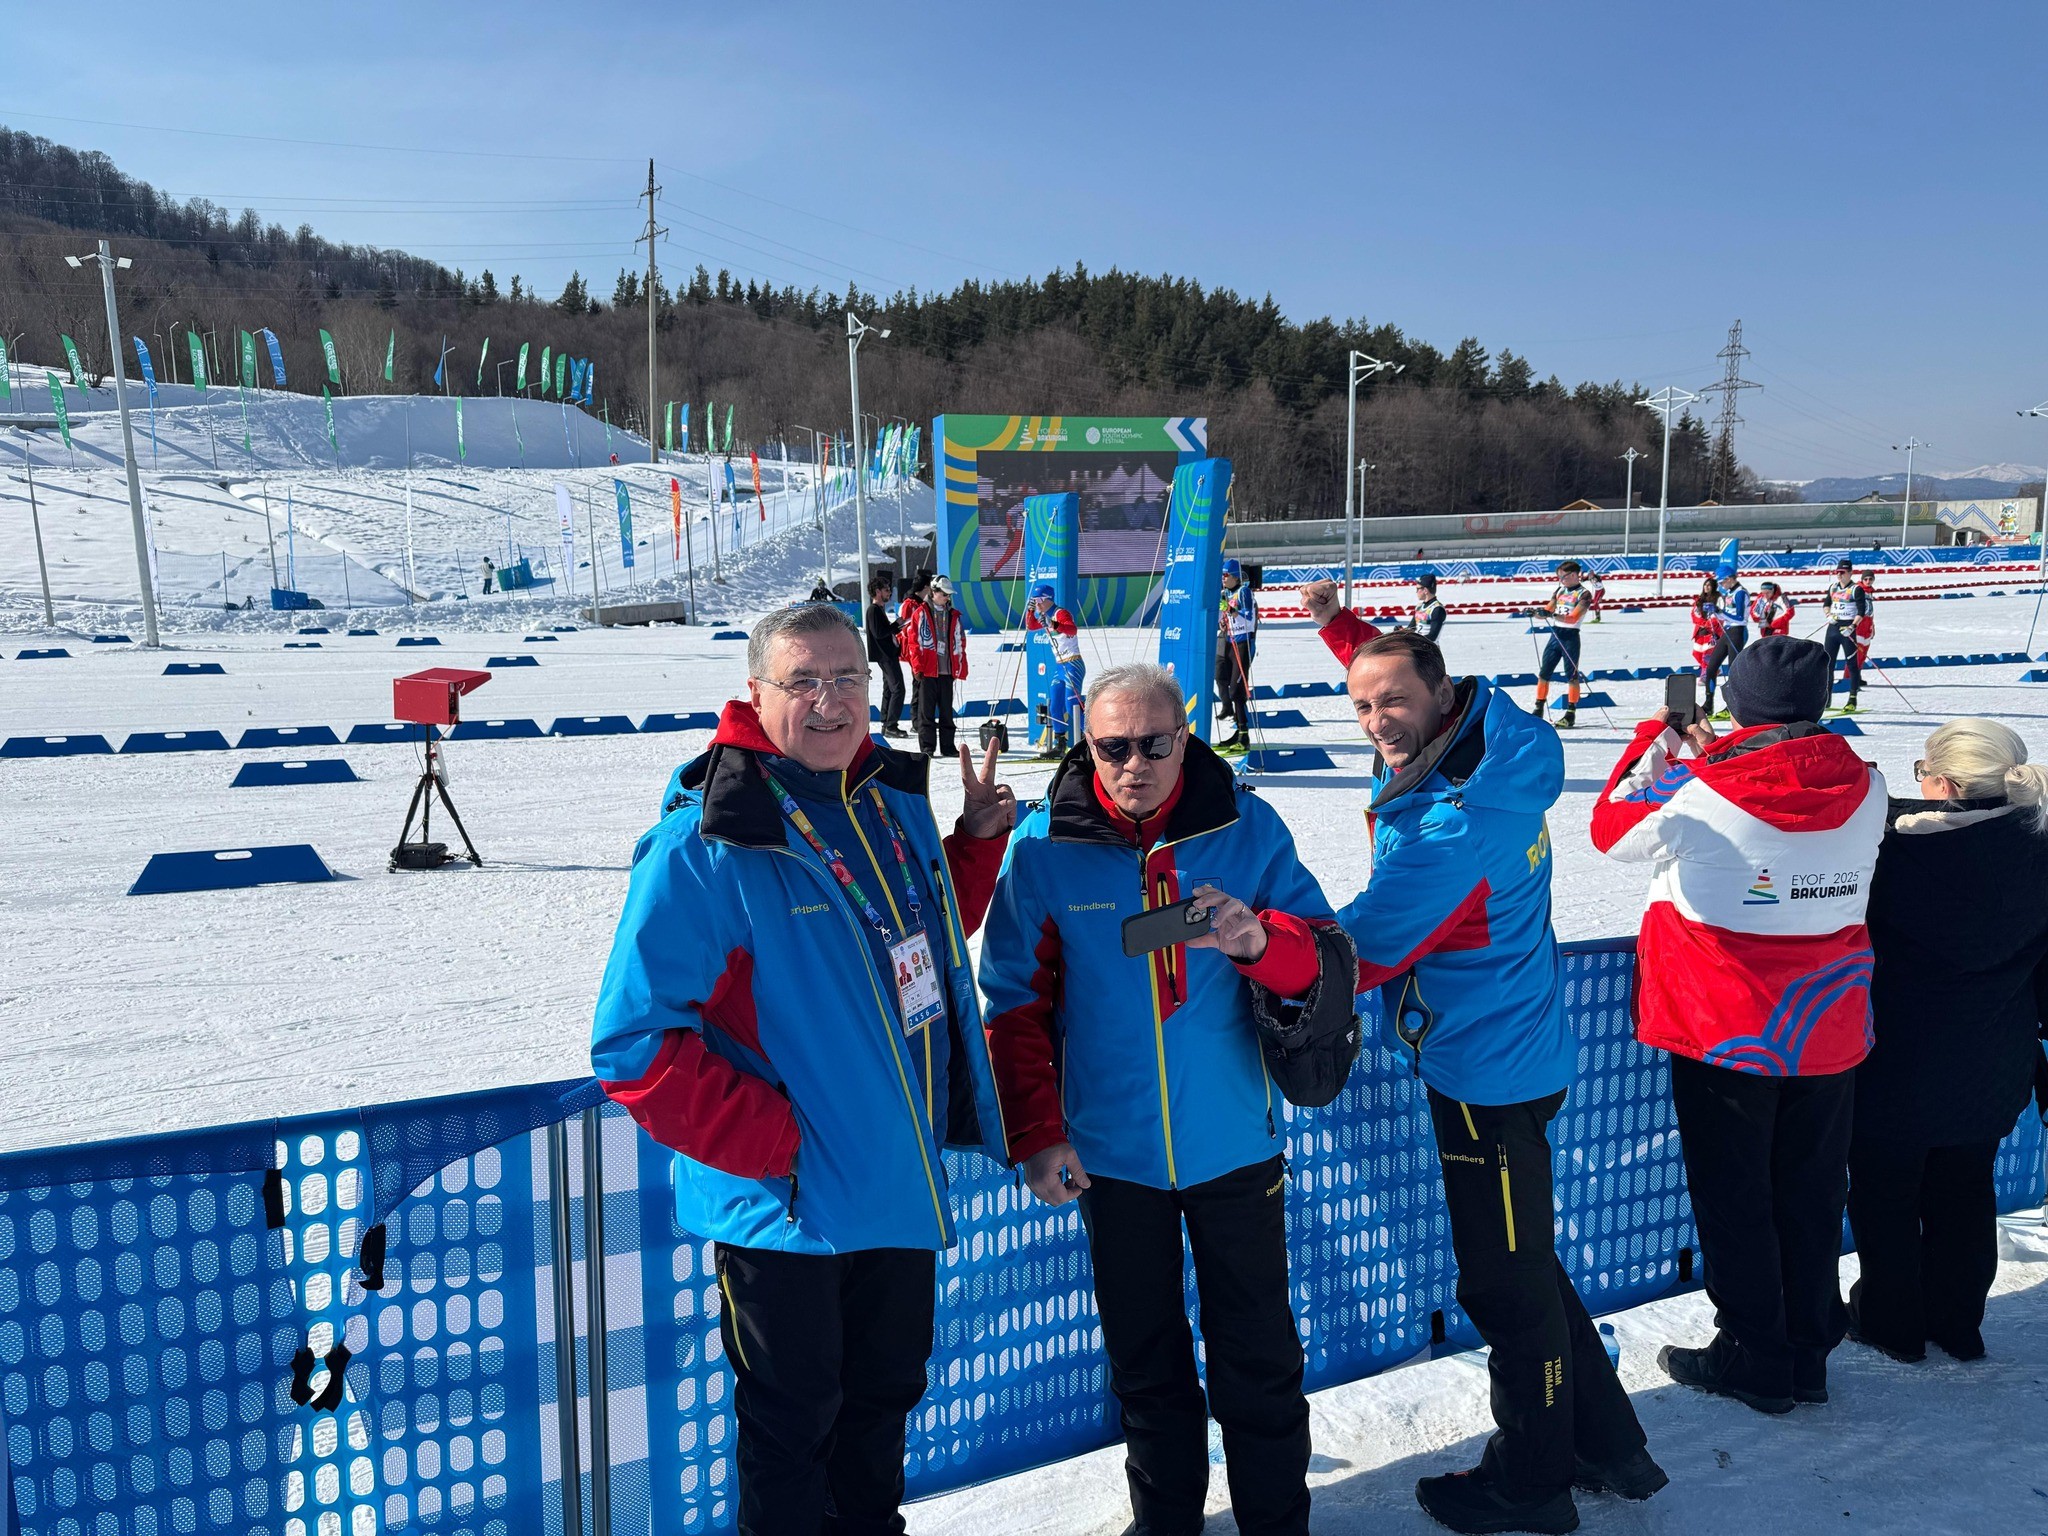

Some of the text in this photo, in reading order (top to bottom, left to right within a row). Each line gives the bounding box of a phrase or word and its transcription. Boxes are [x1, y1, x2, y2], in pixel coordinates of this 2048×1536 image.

[1791, 870, 1860, 886] EYOF 2025
[1790, 883, 1858, 900] BAKURIANI
[1068, 902, 1116, 911] Strindberg
[1554, 1356, 1563, 1386] TEAM
[1544, 1360, 1554, 1408] ROMANIA
